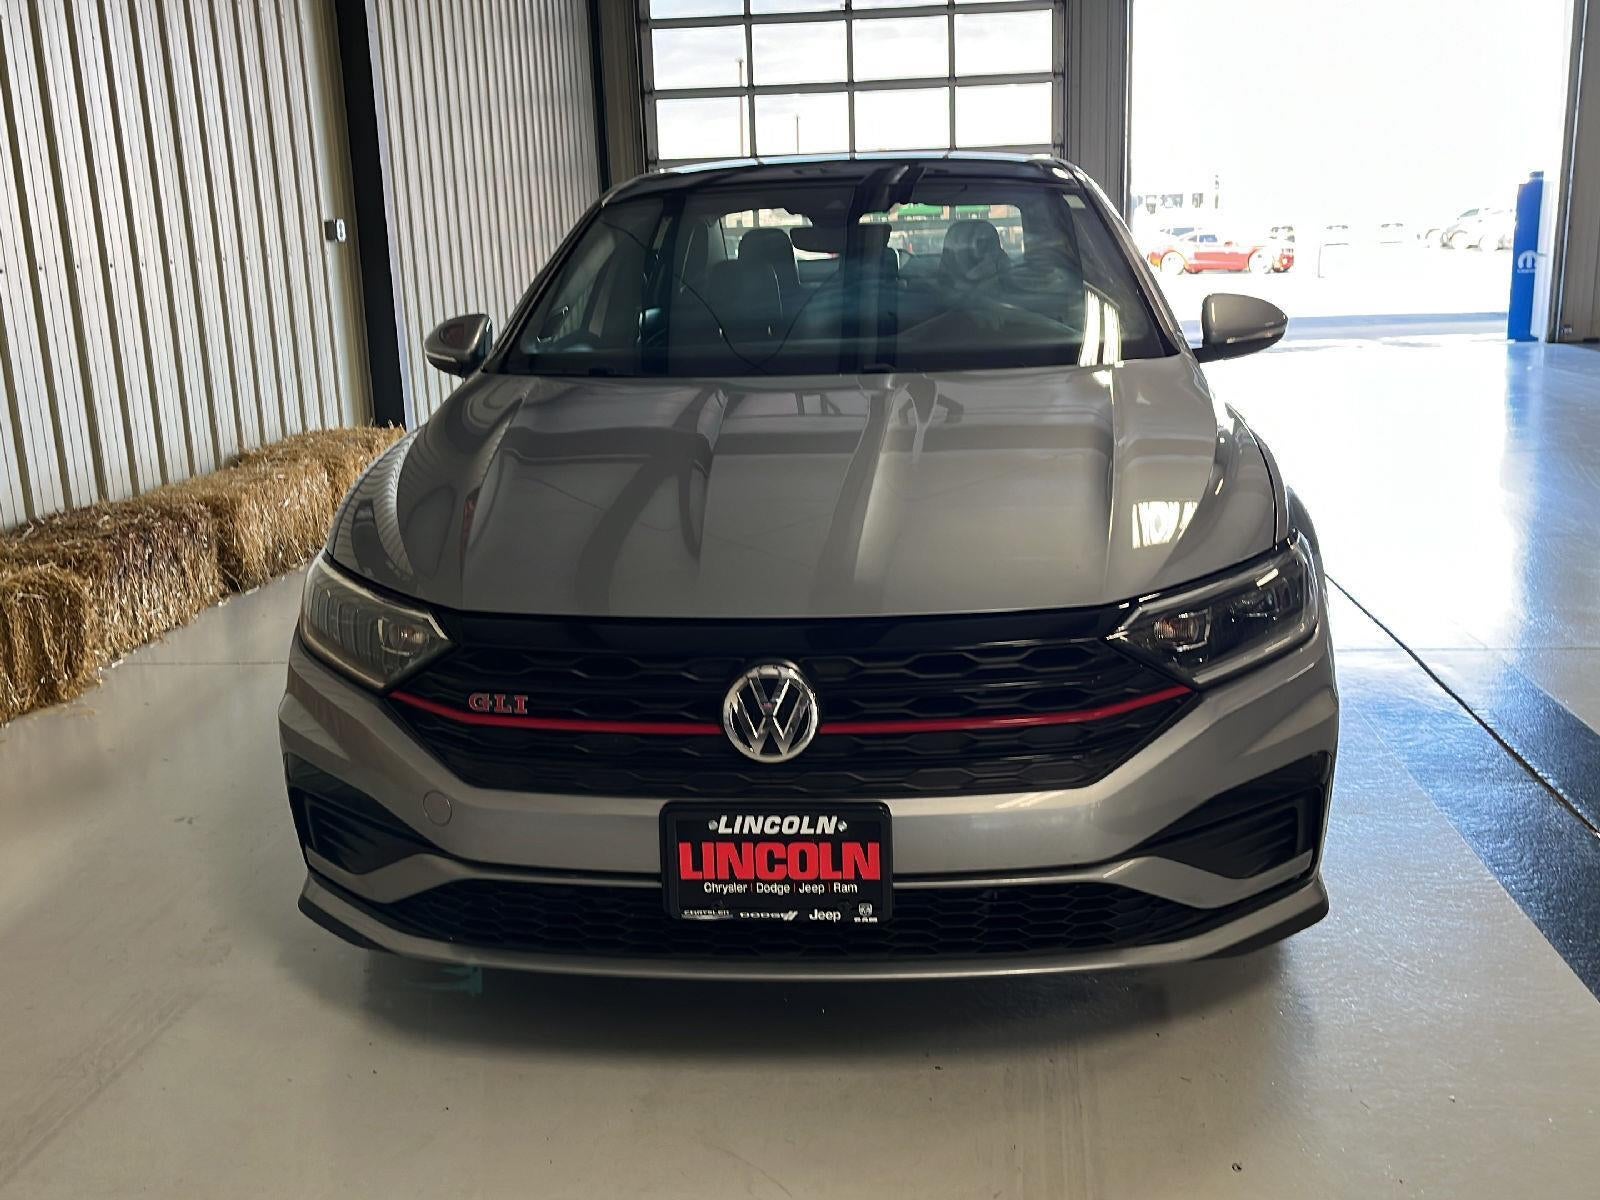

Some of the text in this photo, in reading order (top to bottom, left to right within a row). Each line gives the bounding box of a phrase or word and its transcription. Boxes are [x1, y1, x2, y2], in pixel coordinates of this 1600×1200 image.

[468, 693, 529, 715] GLI
[718, 815, 837, 835] LINCOLN
[678, 842, 881, 880] LINCOLN
[703, 882, 858, 895] Chrysler Dodge Jeep Ram
[808, 908, 842, 923] Jeep
